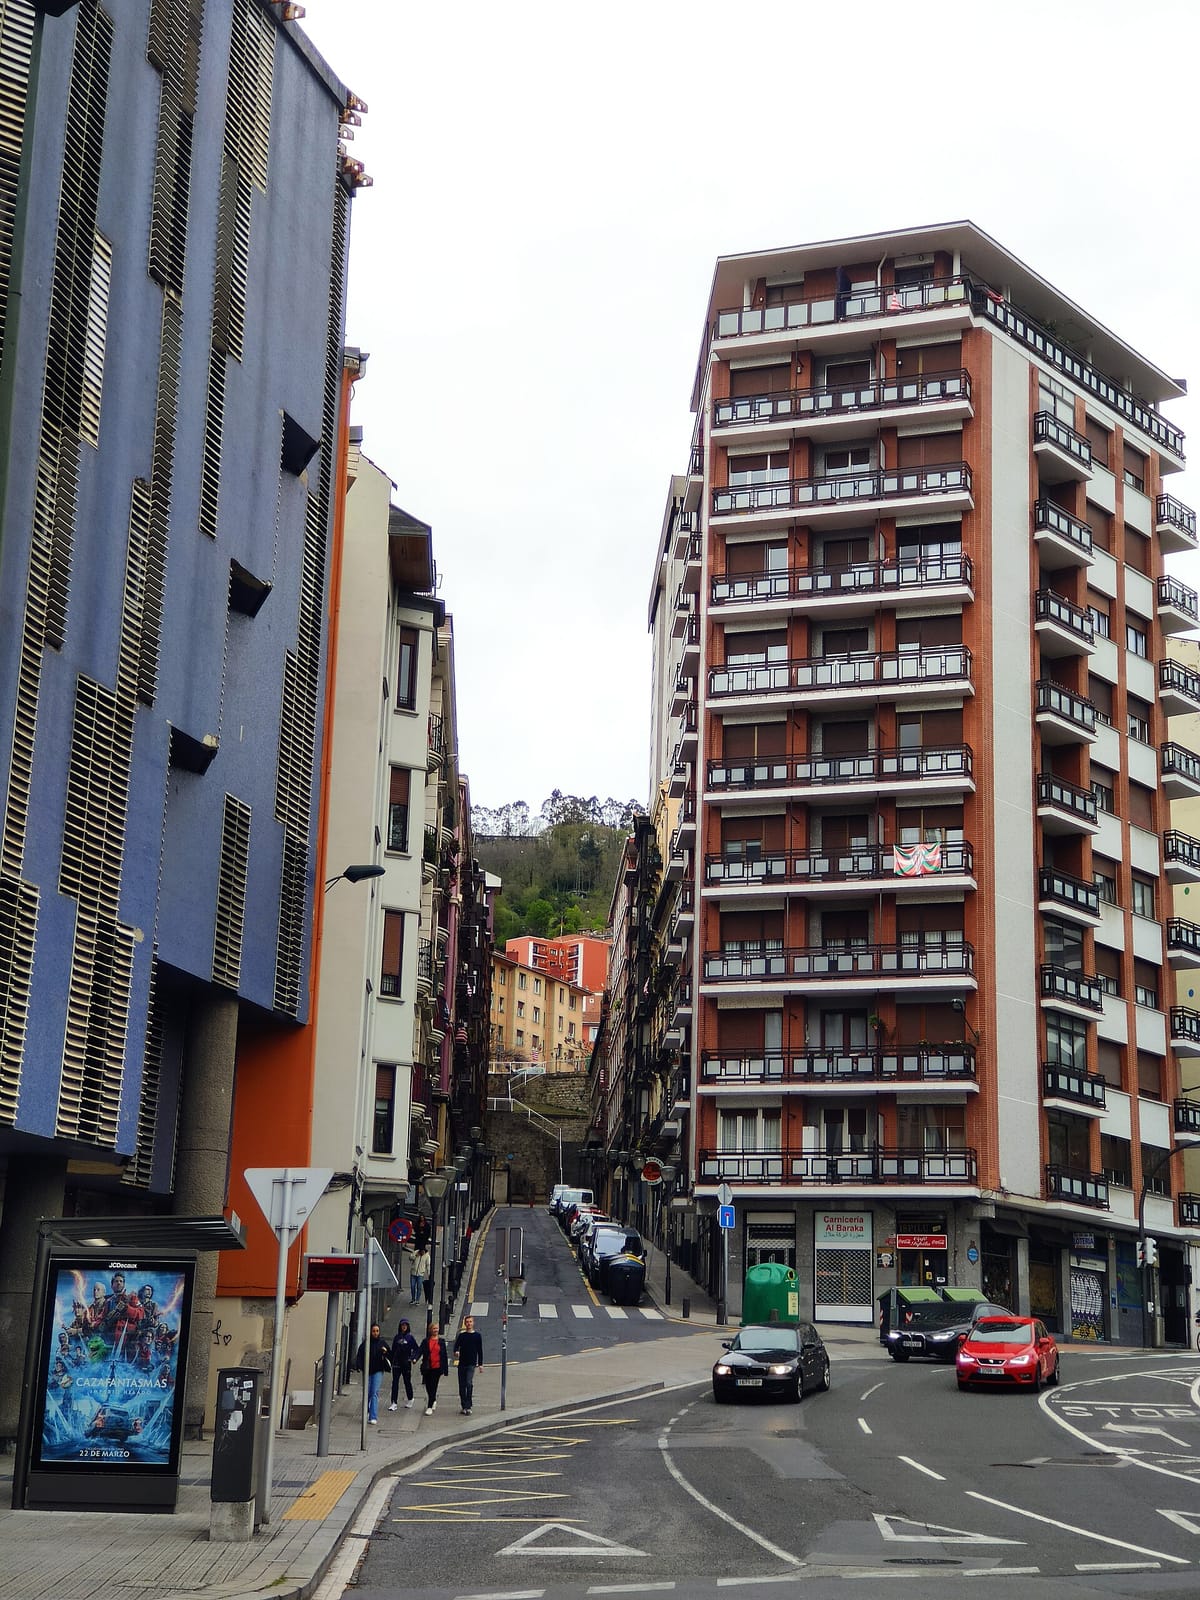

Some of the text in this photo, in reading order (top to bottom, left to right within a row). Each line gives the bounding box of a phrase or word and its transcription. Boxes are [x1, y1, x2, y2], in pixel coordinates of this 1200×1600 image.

[823, 1215, 864, 1224] Carnicería
[825, 1224, 864, 1232] Al Baraka
[76, 1377, 168, 1389] CAZAFANTASMAS
[1061, 1406, 1198, 1419] STOP
[79, 1449, 89, 1457] 22
[101, 1450, 130, 1458] MARZO
